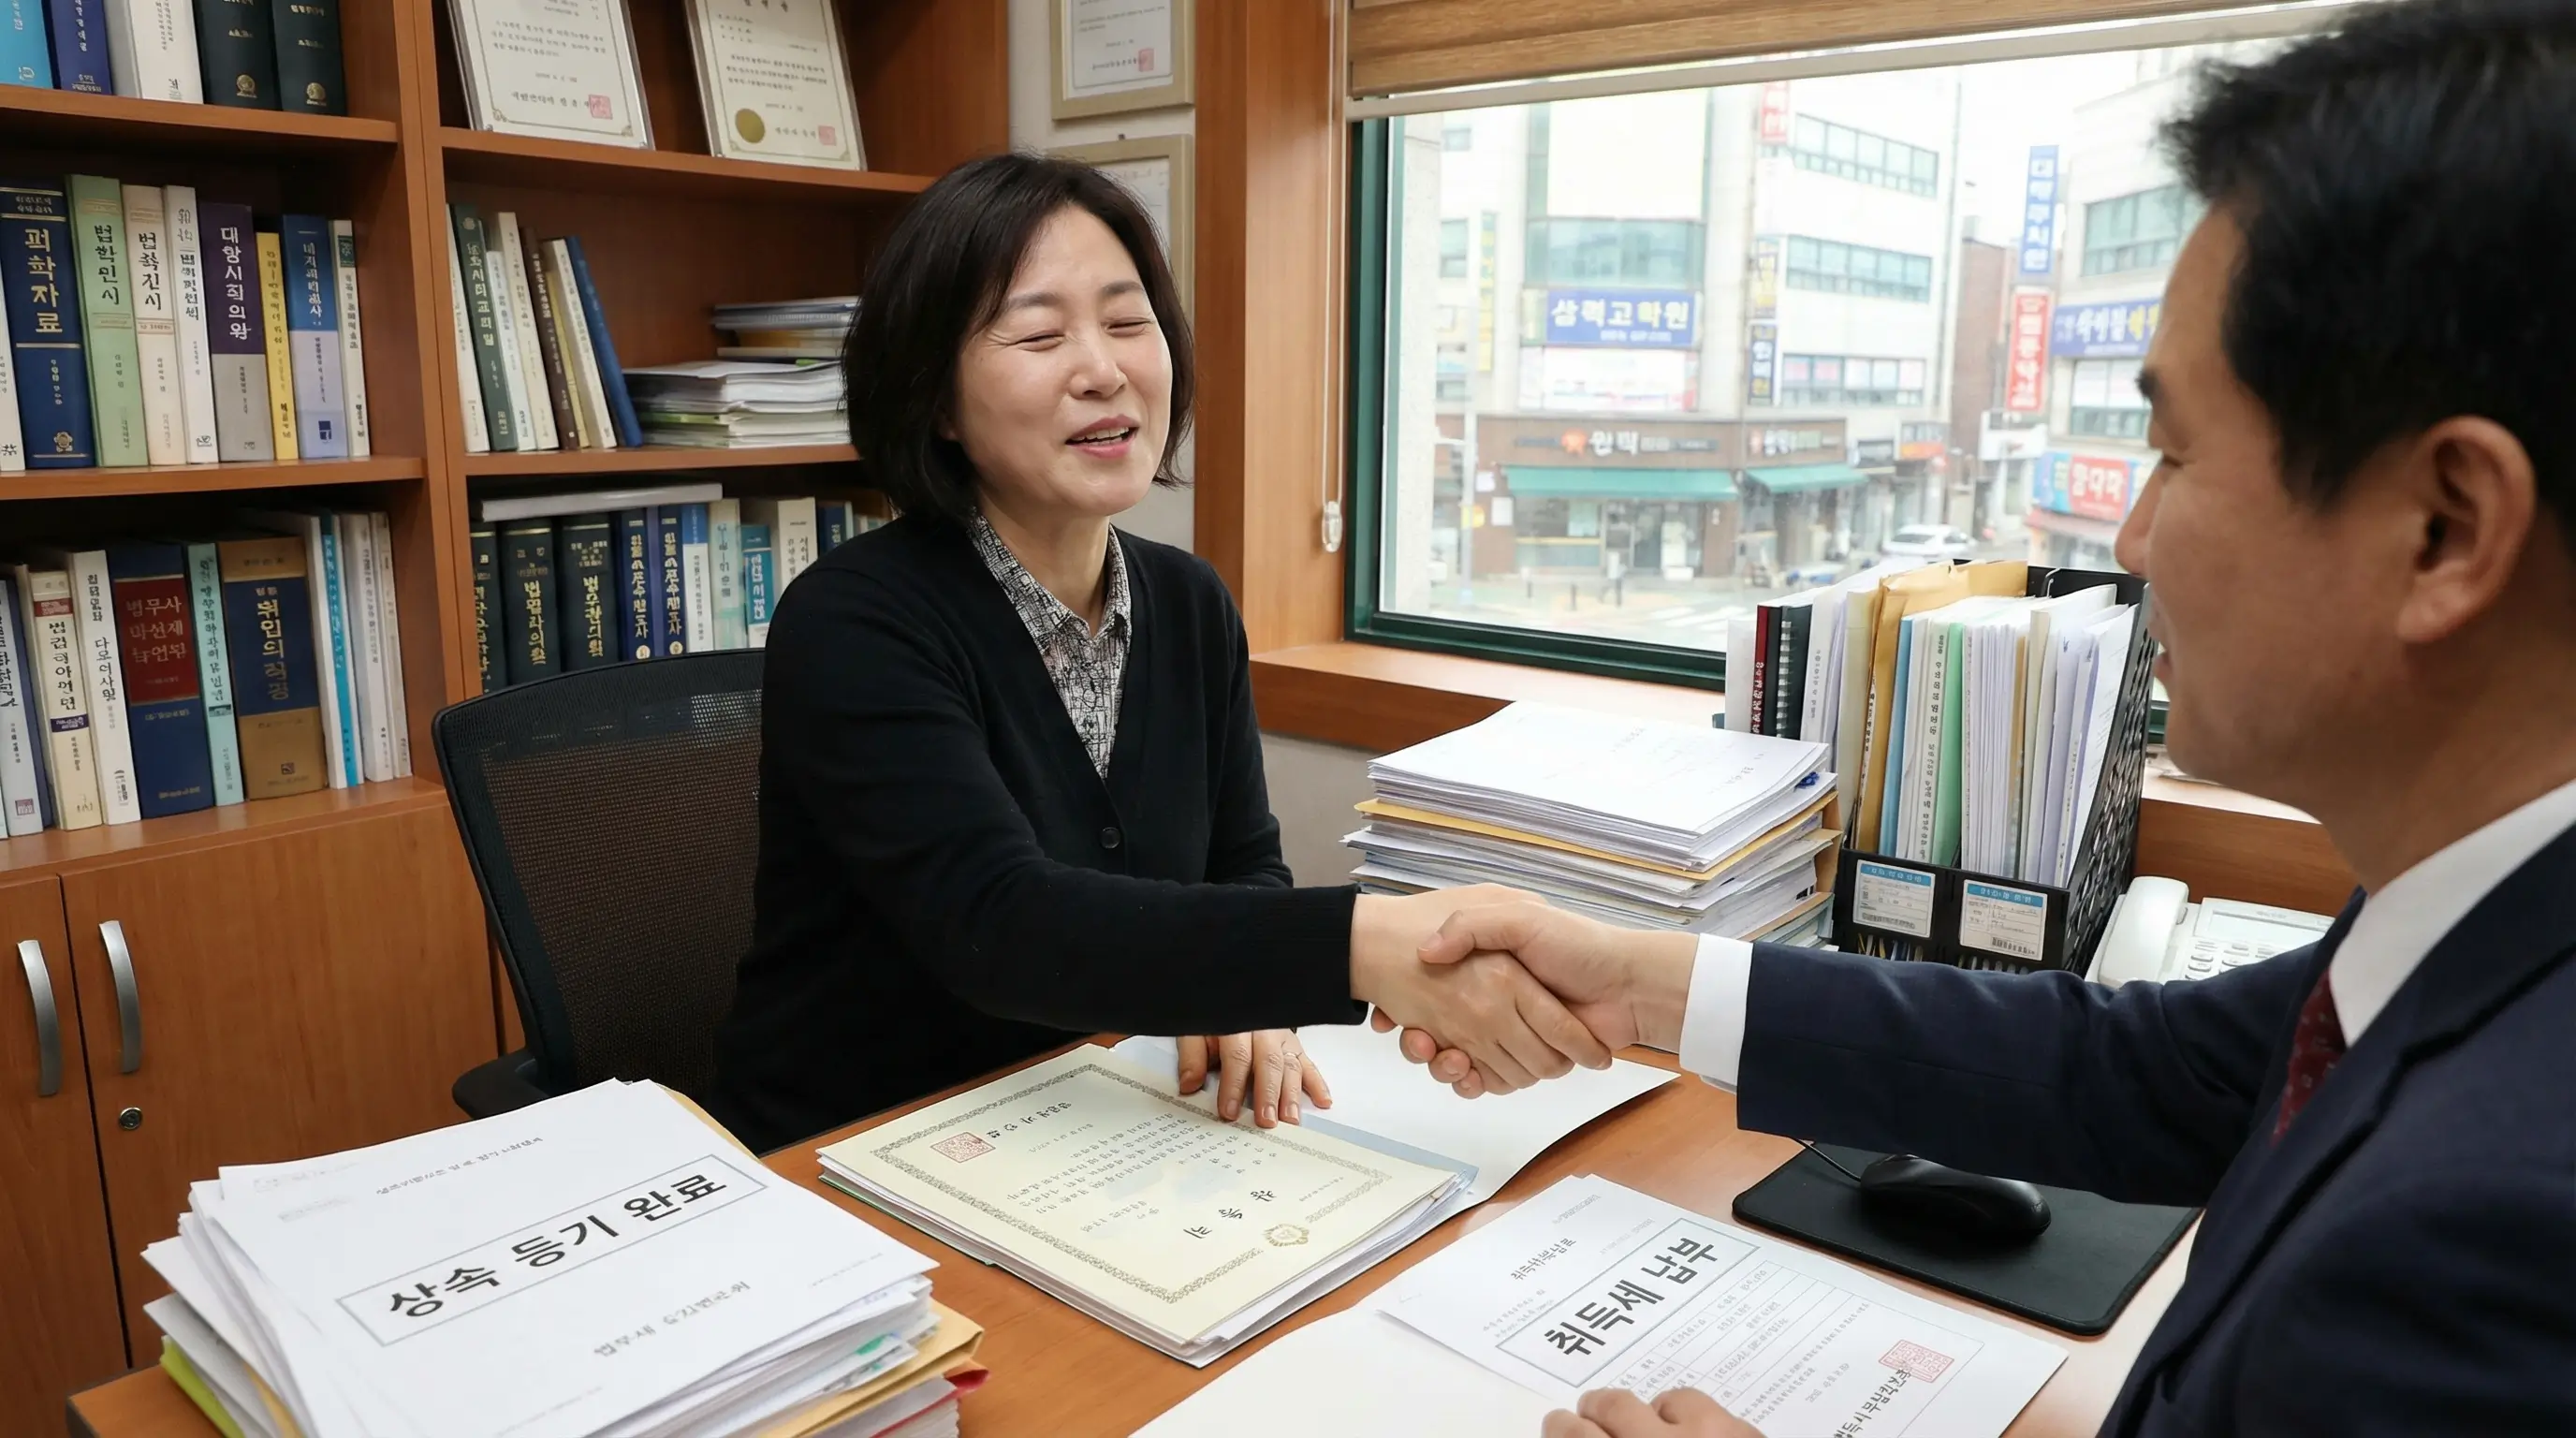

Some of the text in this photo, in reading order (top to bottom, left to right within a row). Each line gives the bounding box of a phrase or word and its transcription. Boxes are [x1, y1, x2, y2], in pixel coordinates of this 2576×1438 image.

[389, 1174, 727, 1317] 상속 등기 완료
[1544, 1237, 1719, 1356] 취득세 납부
